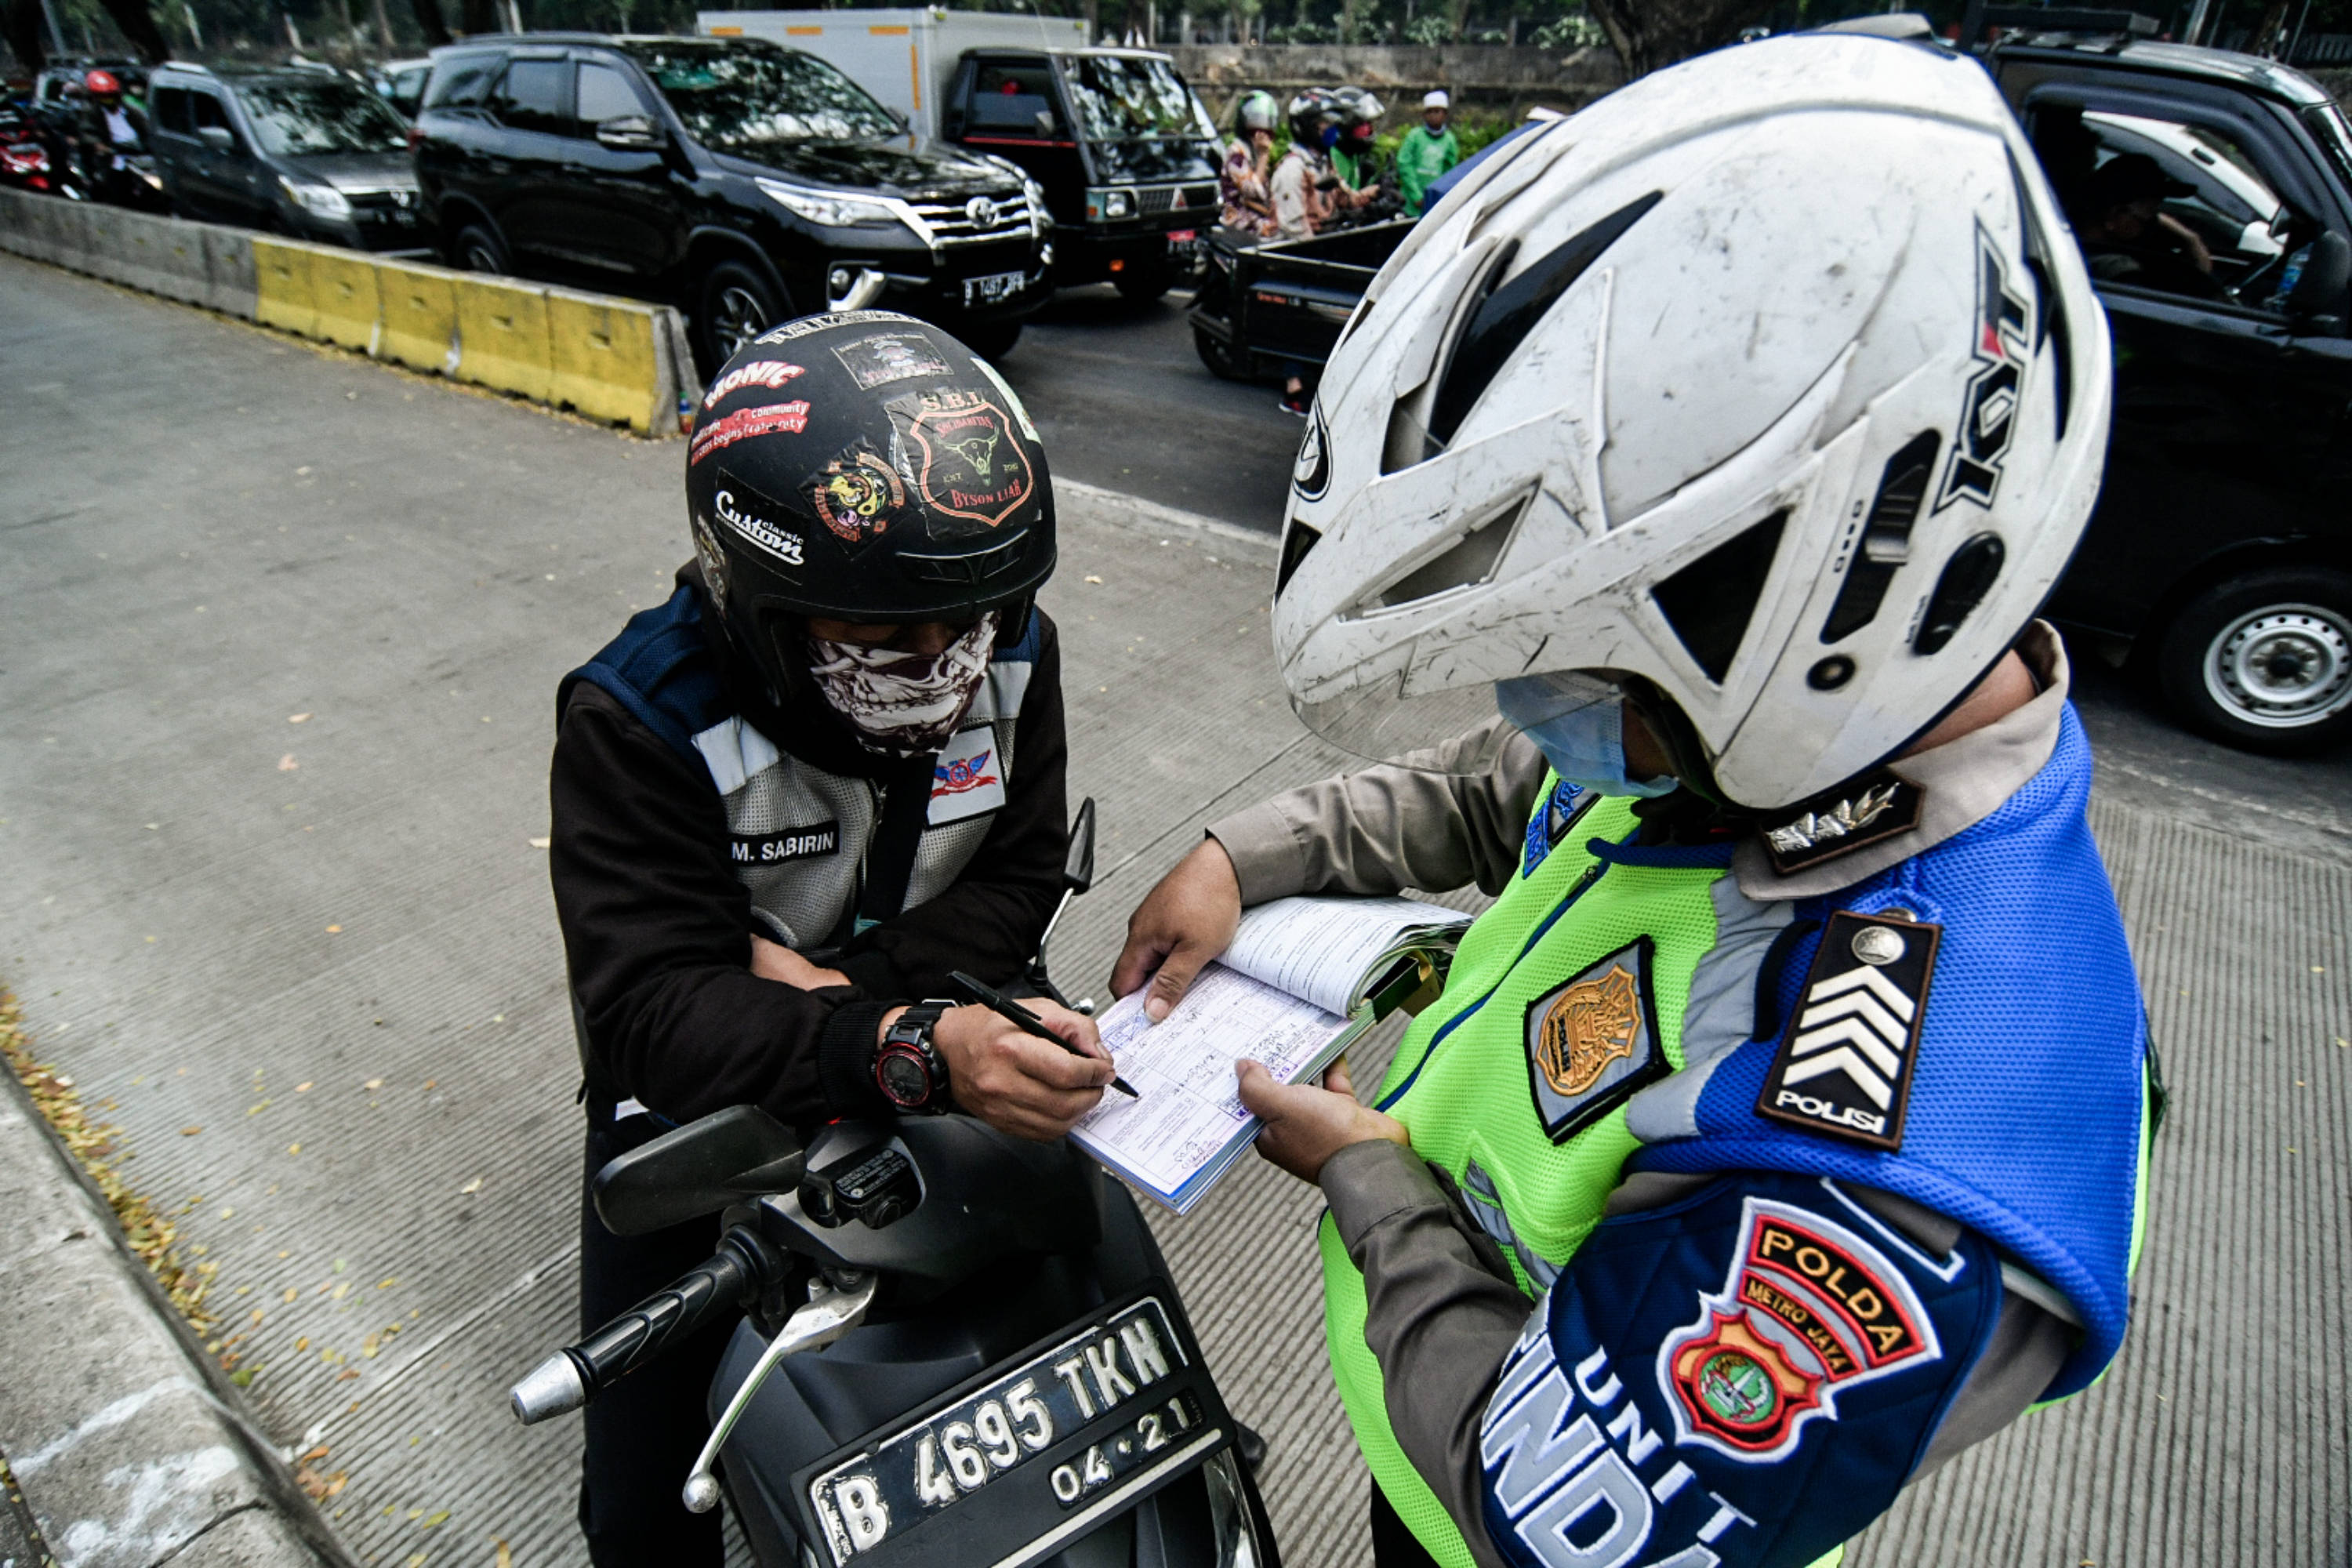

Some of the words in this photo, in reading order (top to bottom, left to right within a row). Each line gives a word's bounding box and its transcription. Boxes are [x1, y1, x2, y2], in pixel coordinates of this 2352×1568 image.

[750, 403, 808, 419] community
[716, 490, 804, 564] Custom
[950, 489, 994, 509] BYSON
[762, 521, 804, 545] classic
[731, 841, 755, 862] M.
[761, 831, 834, 860] SABIRIN
[1775, 1089, 1886, 1135] POLISI
[1762, 1229, 1904, 1355] POLDA
[1747, 1279, 1808, 1324] METRO
[1806, 1327, 1848, 1370] JAYA
[834, 1475, 890, 1553] B
[915, 1377, 1054, 1508] 4695
[1574, 1344, 1757, 1543] UNIT
